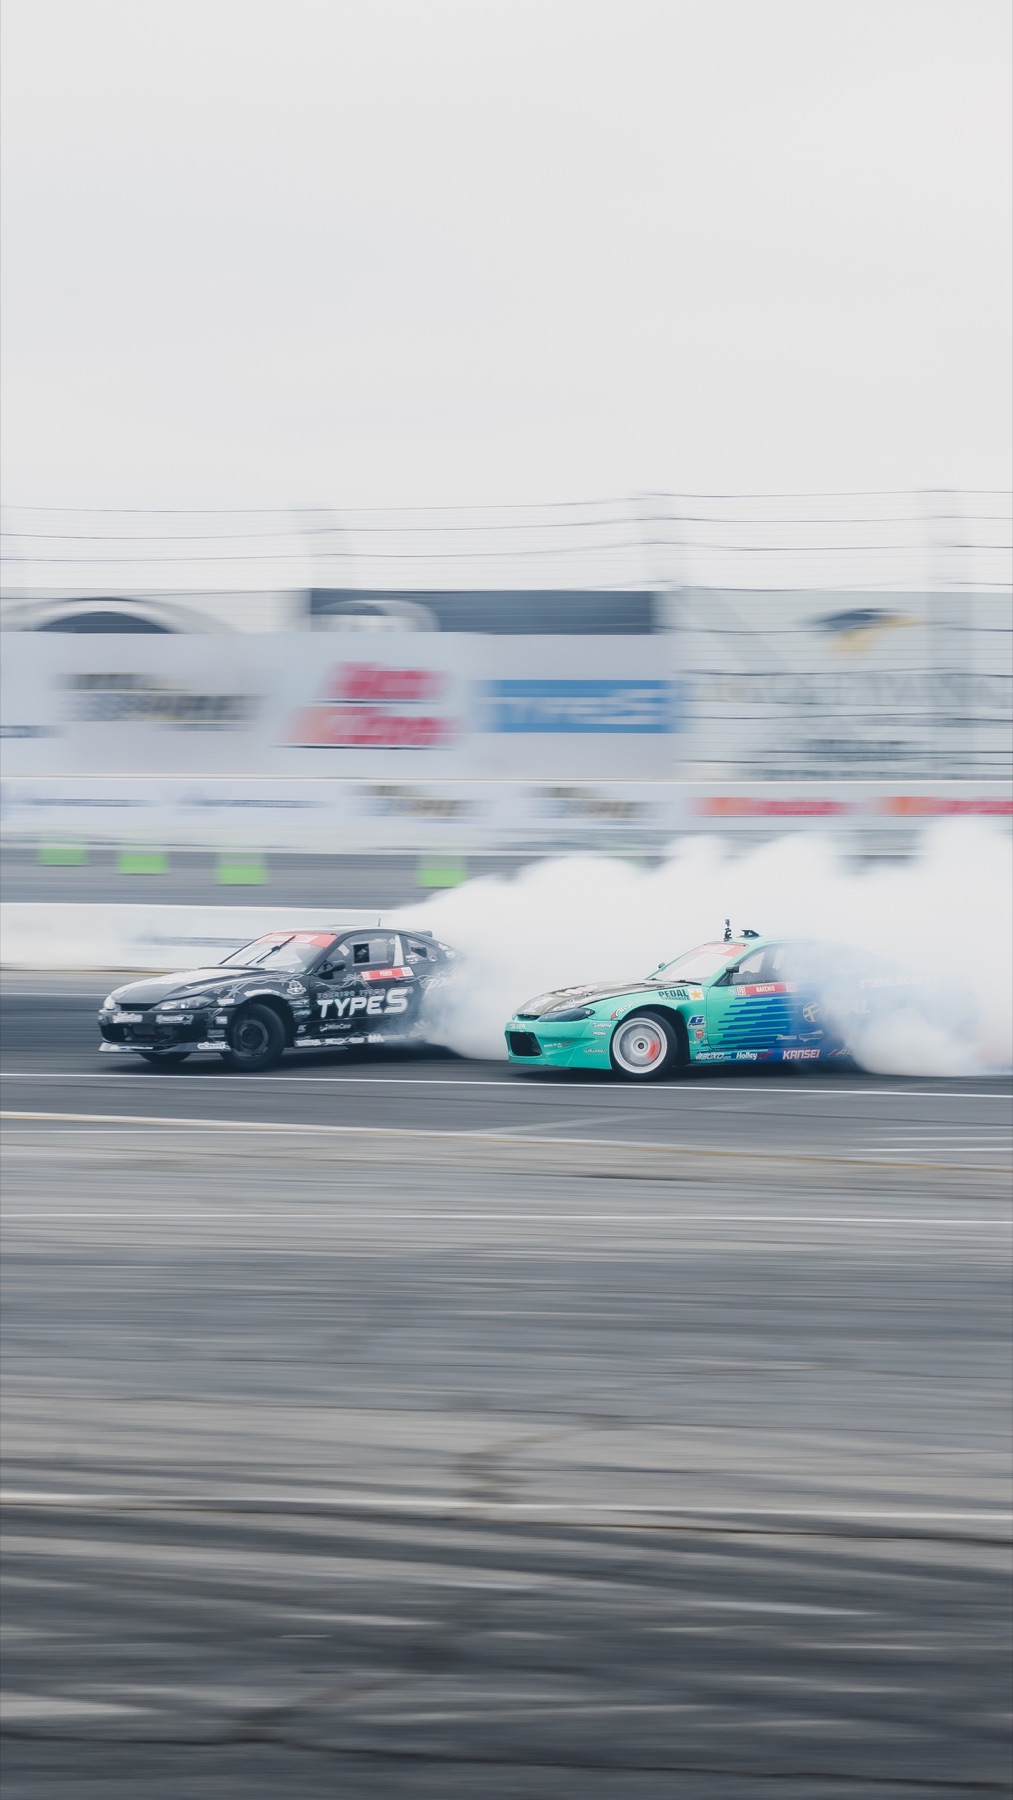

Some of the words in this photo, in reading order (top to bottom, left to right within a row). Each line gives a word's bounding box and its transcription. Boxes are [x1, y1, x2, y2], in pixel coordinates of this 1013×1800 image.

[658, 989, 690, 999] PEDAL
[736, 1051, 758, 1061] Holley
[782, 1049, 820, 1060] KANSEI
